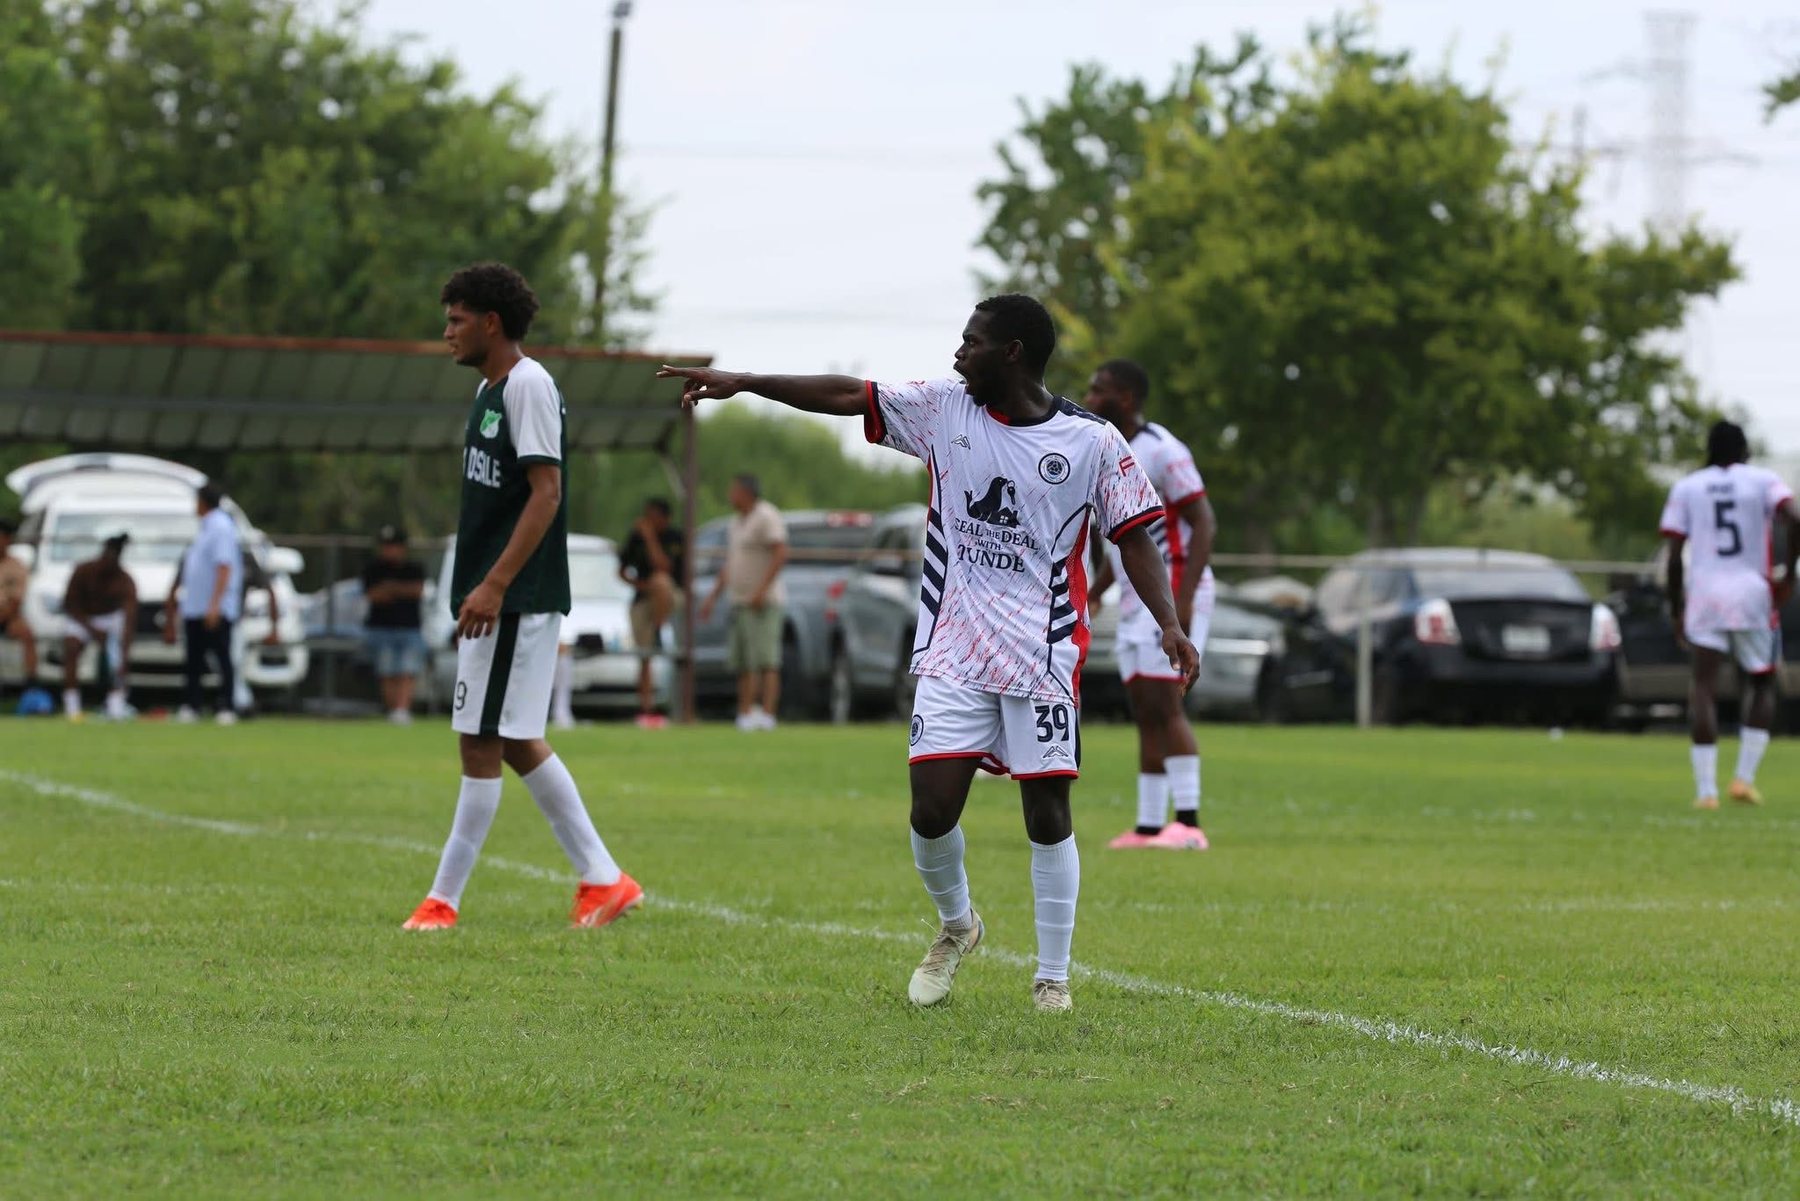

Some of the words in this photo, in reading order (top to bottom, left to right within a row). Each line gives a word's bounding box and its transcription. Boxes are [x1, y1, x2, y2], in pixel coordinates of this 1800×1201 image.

[985, 529, 1000, 540] THE
[1001, 531, 1038, 550] DEAL
[1715, 500, 1742, 557] 5
[977, 539, 1001, 551] WITH
[455, 681, 467, 710] 9
[1034, 704, 1070, 743] 39
